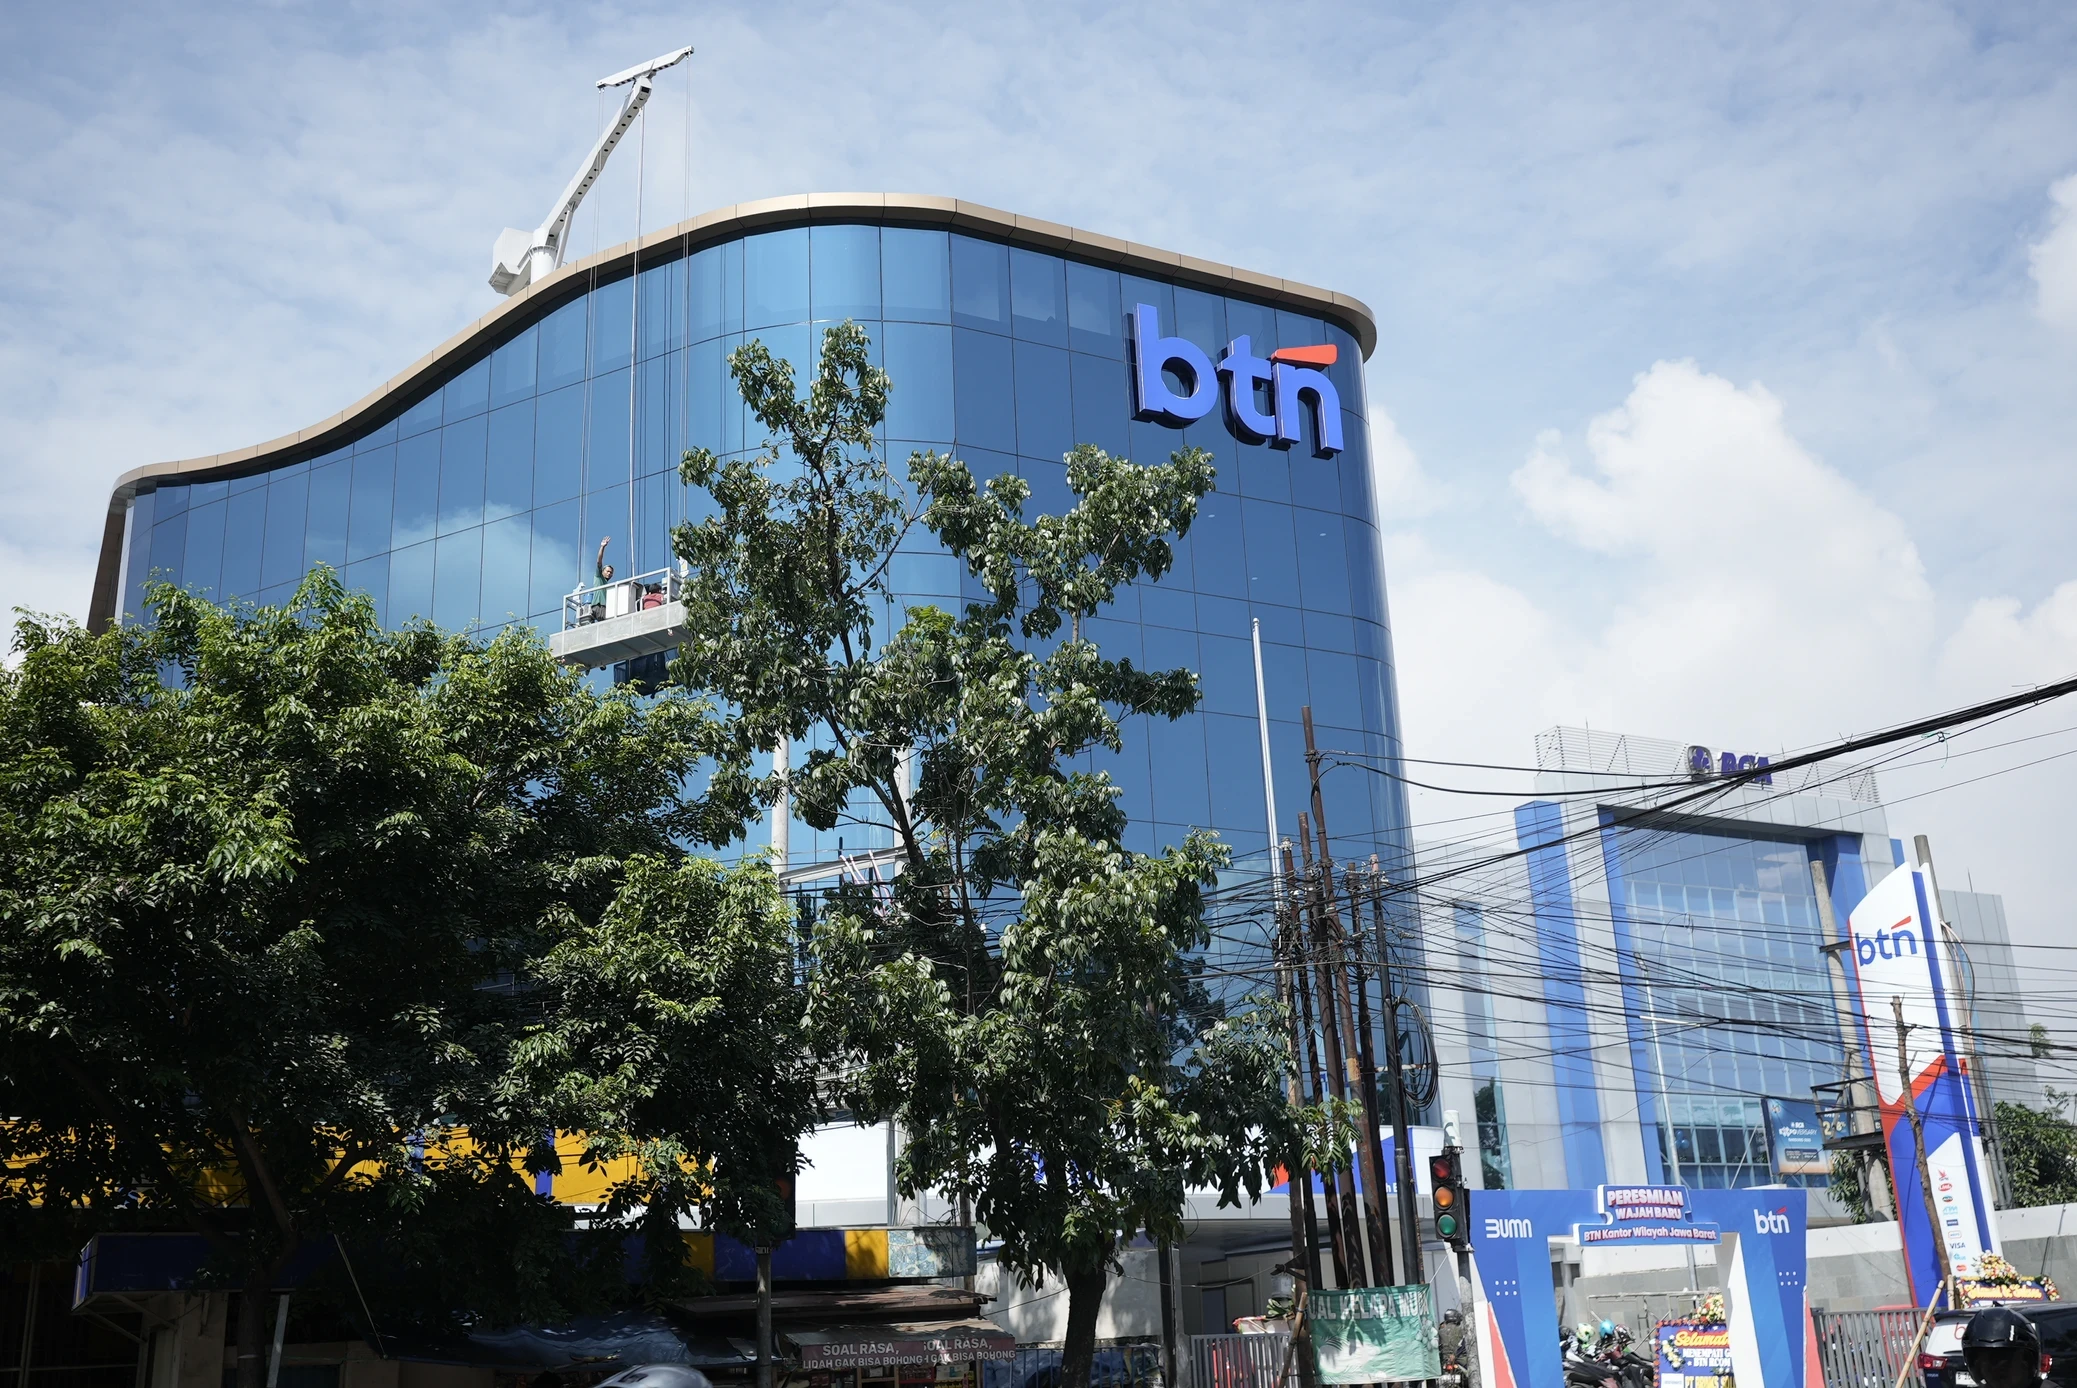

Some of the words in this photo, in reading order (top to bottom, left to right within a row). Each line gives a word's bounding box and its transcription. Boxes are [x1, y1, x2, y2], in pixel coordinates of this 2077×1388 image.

[1134, 302, 1344, 453] btn
[1720, 752, 1772, 785] BCA
[1855, 915, 1917, 966] btn
[1607, 1189, 1684, 1207] PERESMIAN
[1615, 1207, 1654, 1220] WAJAH
[1654, 1207, 1682, 1220] BARU
[1754, 1206, 1790, 1234] btn
[1584, 1230, 1601, 1241] BTN
[1602, 1228, 1632, 1239] Kantor
[1633, 1226, 1668, 1240] Wilayah
[1669, 1227, 1693, 1238] Jawa
[1693, 1228, 1717, 1240] Barat
[1340, 1294, 1397, 1320] KELAPA
[954, 1338, 993, 1350] RASA,
[1674, 1331, 1730, 1347] Selamat
[823, 1343, 857, 1356] SOAL
[860, 1342, 899, 1355] RASA,
[952, 1352, 975, 1362] BISA
[977, 1350, 1016, 1360] BOHONG
[803, 1359, 833, 1370] LIDAH
[835, 1358, 856, 1368] GAK
[858, 1357, 881, 1367] BISA
[883, 1356, 923, 1366] BOHONG
